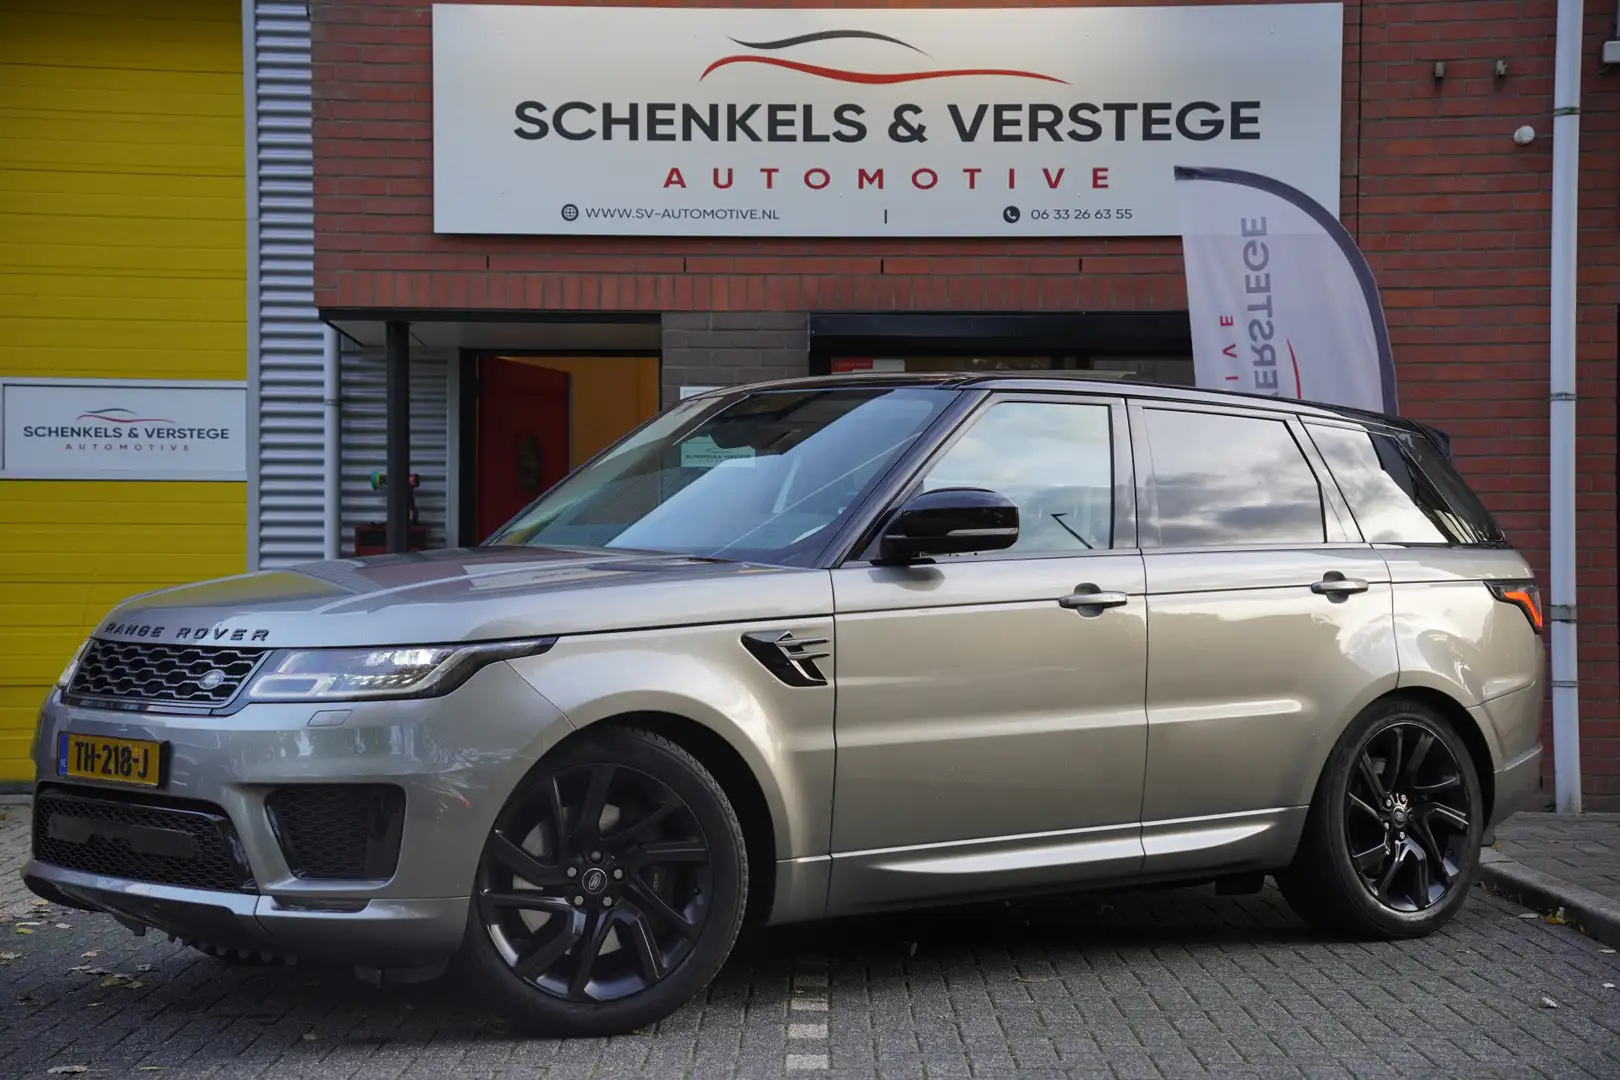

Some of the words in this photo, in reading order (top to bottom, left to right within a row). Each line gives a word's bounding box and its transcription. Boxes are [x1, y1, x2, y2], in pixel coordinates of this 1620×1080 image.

[514, 101, 868, 143] SCHENKELS
[887, 103, 929, 143] &
[947, 101, 1261, 143] VERSTEGE
[663, 167, 1110, 190] AUTOMOTIVE
[585, 207, 780, 220] WWW.SV-AUTOMOTIVE.NL
[1031, 209, 1049, 220] 06
[1053, 209, 1070, 220] 33
[1074, 209, 1091, 220] 26
[1094, 209, 1112, 220] 63
[1116, 208, 1133, 220] 55
[24, 426, 123, 439] SCHENKELS
[128, 427, 139, 439] &
[144, 428, 230, 440] VERSTEGE
[65, 443, 190, 452] AUTOMOTIVE
[104, 622, 165, 638] RANGE
[176, 627, 270, 642] ROVER
[75, 742, 149, 778] TH-218-J
